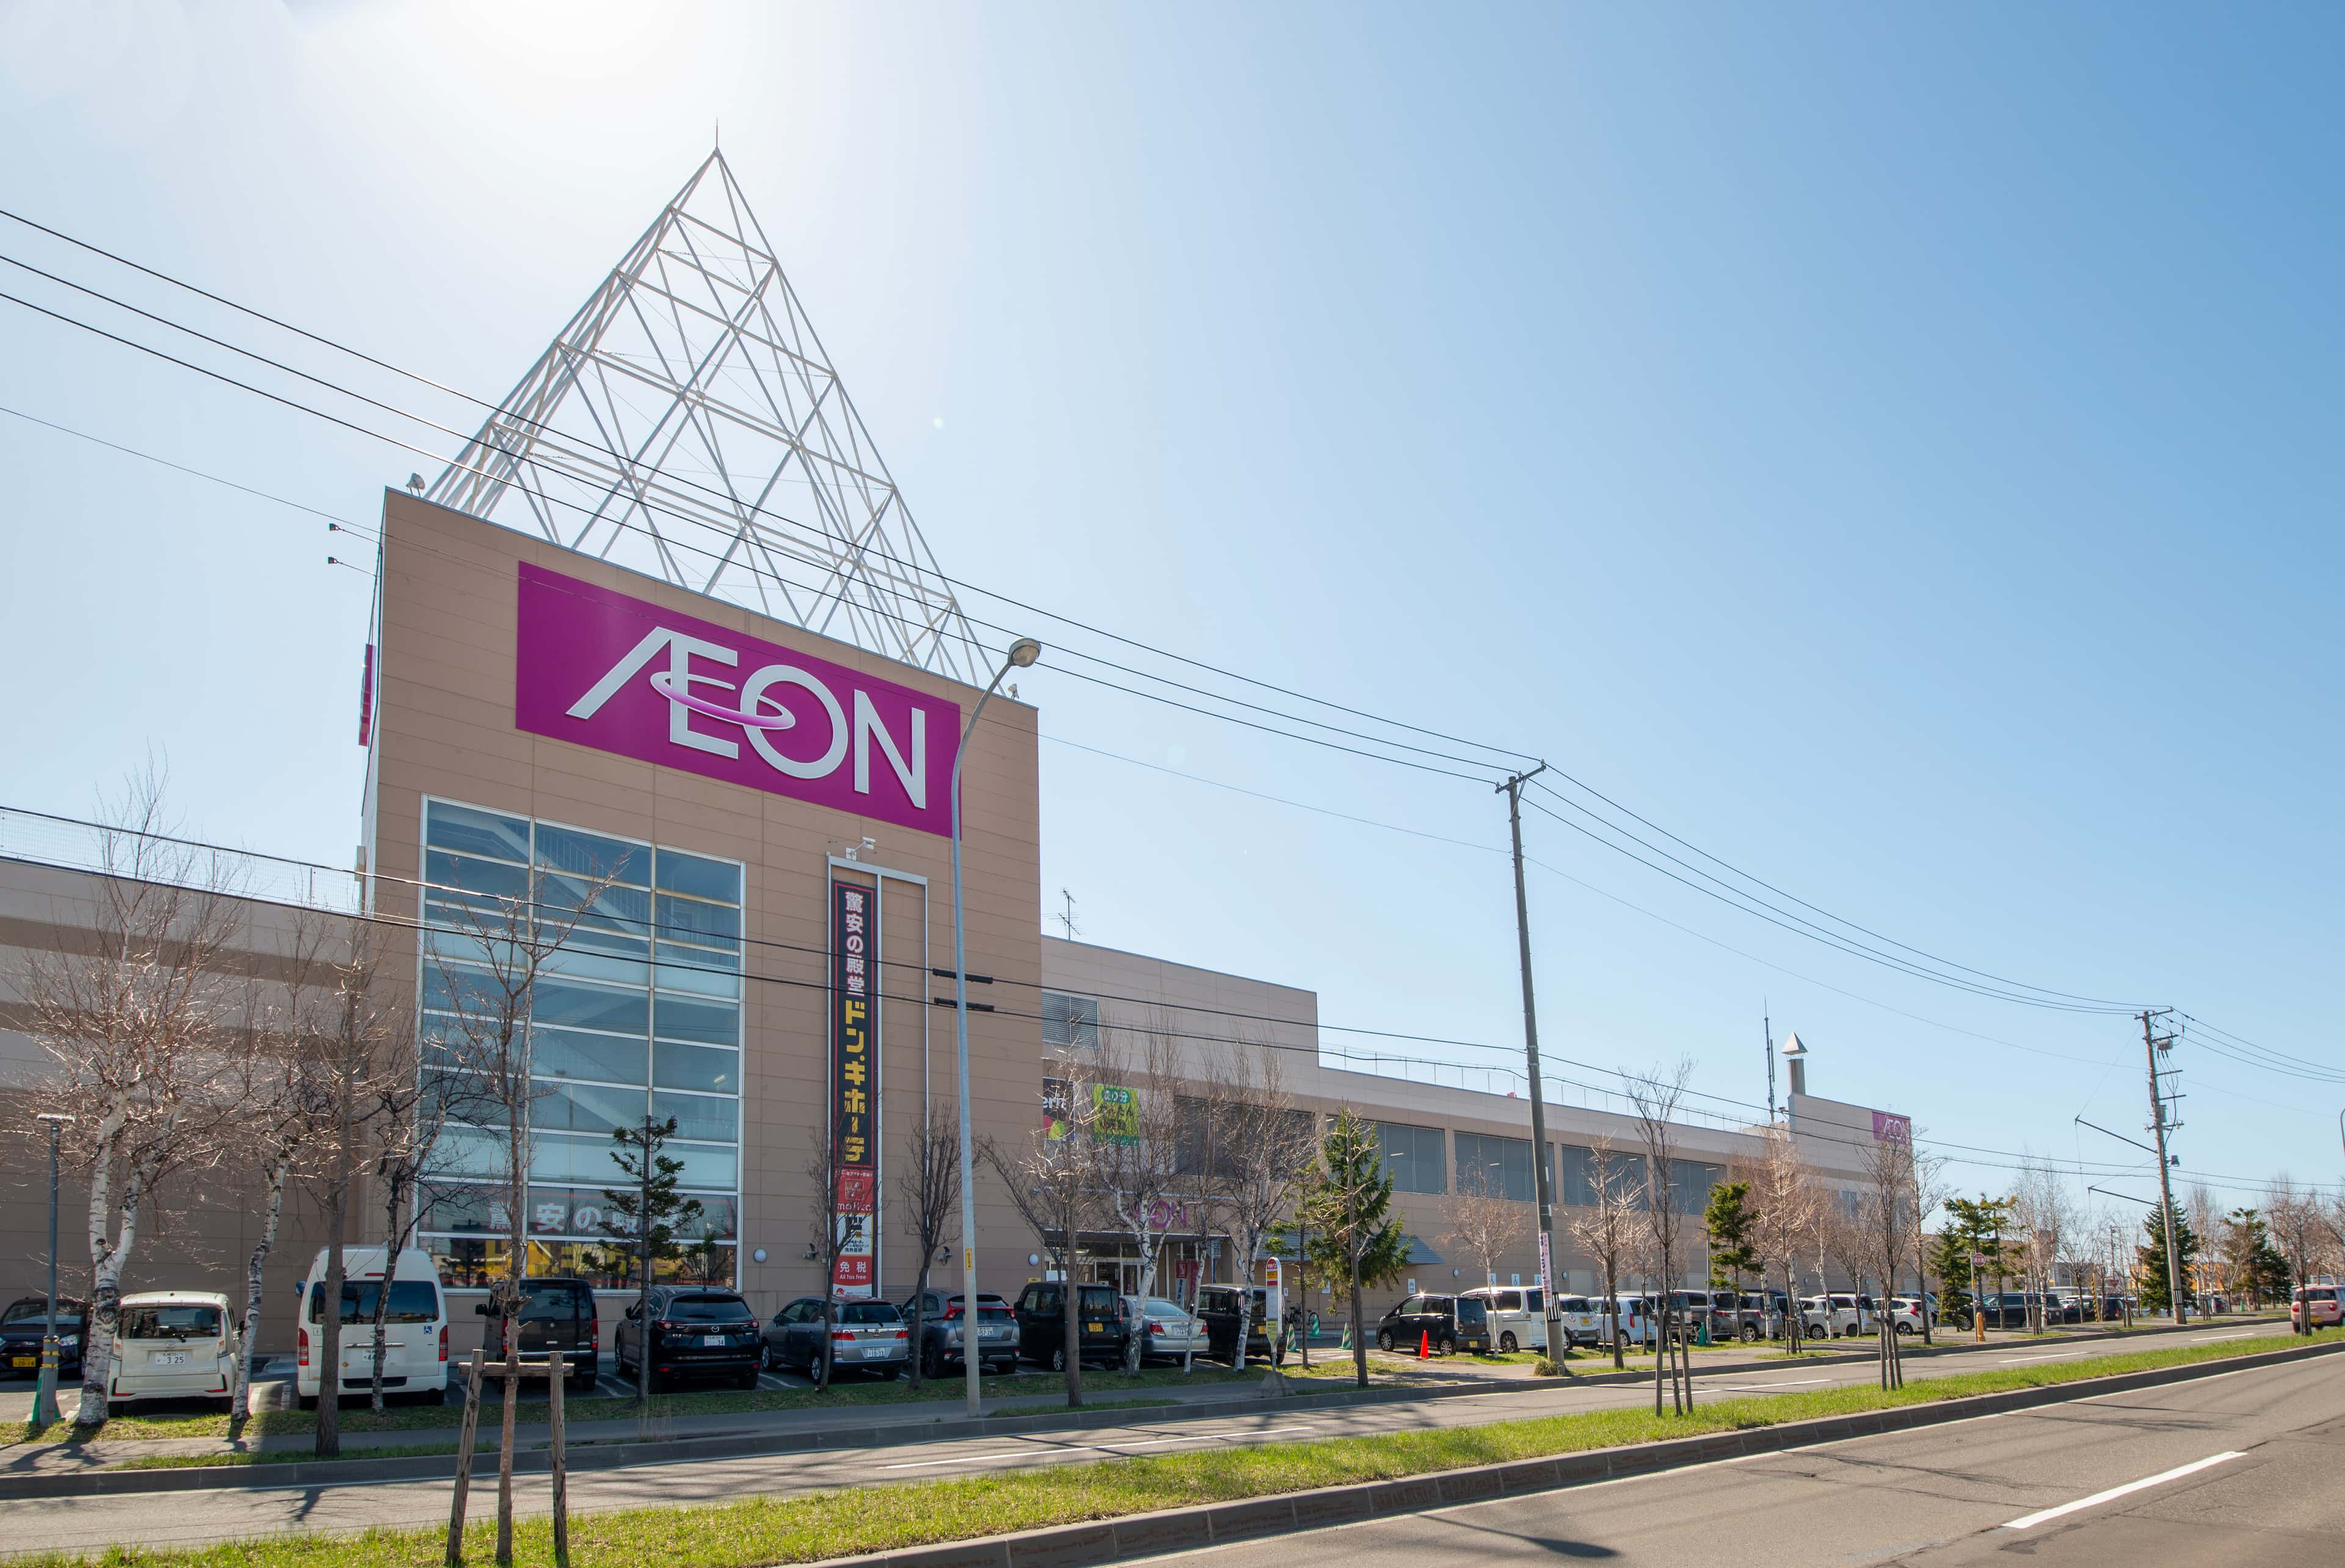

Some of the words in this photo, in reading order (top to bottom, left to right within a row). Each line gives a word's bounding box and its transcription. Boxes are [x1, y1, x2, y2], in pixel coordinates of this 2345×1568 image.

[845, 891, 865, 996] 驚安の殿堂
